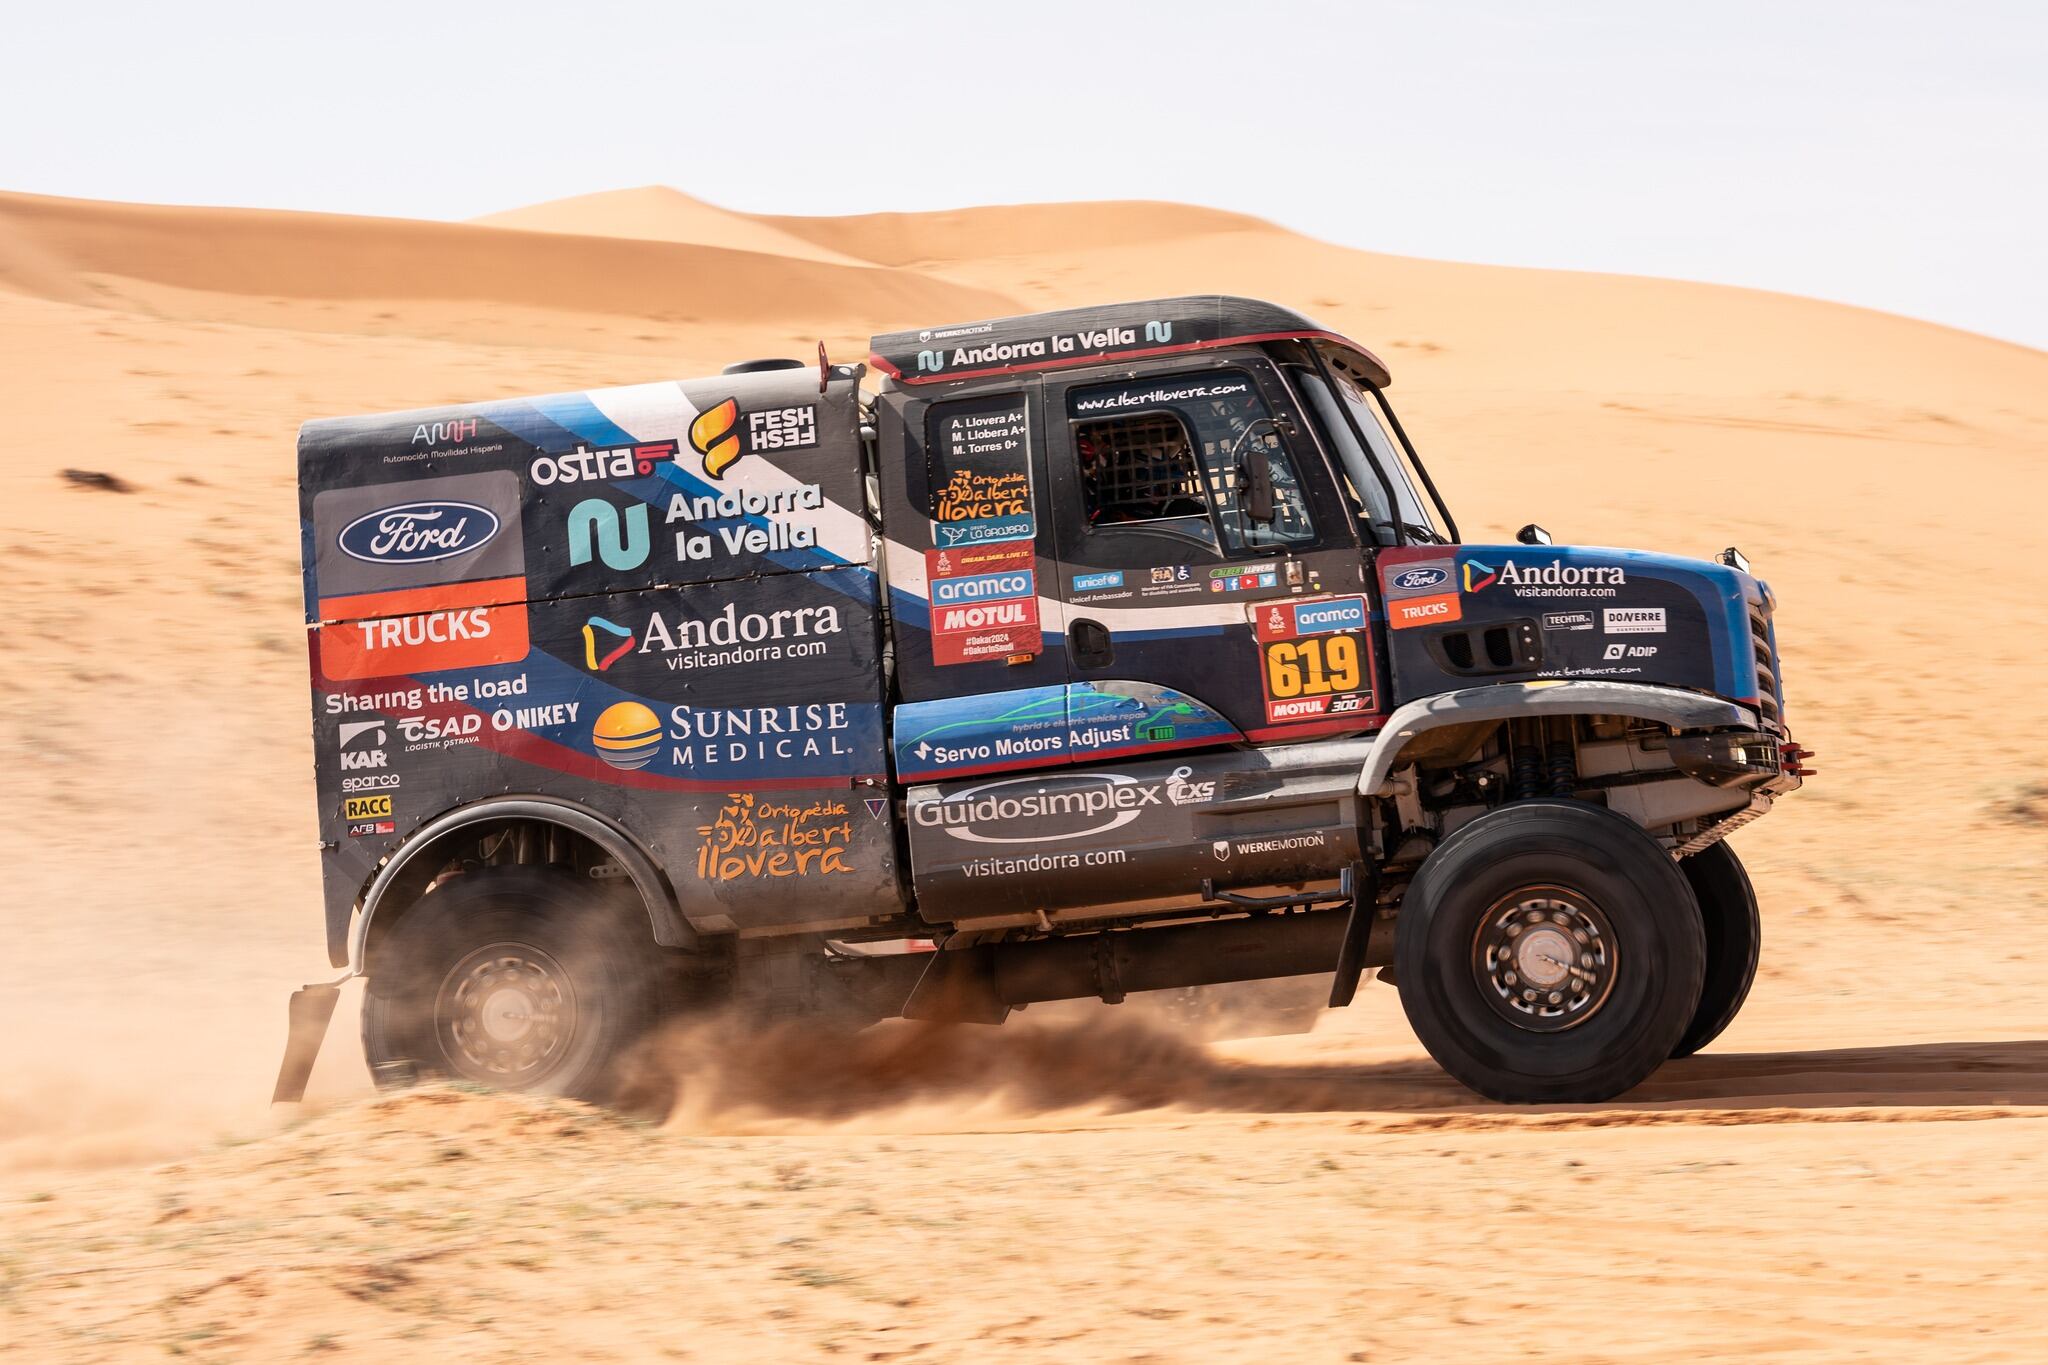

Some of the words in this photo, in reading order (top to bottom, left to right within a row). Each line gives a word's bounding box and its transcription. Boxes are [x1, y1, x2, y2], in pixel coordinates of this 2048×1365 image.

[951, 341, 1045, 366] Andorra
[1052, 334, 1073, 352] la
[1077, 327, 1135, 349] Vella
[1076, 384, 1247, 409] www.albertllovera.com
[749, 406, 814, 431] FESH
[951, 419, 963, 428] A.
[966, 414, 1005, 427] Llovera
[1007, 412, 1023, 423] A+
[951, 432, 965, 441] M.
[967, 427, 1008, 440] Llobera
[1010, 425, 1025, 435] A+
[383, 451, 428, 463] Automoción
[430, 447, 468, 458] Movilidad
[470, 443, 502, 454] Hispania
[953, 445, 965, 455] M.
[968, 441, 1002, 453] Torres
[974, 483, 1028, 500] albert
[665, 484, 822, 524] Andorra
[937, 499, 1031, 520] llovera
[369, 509, 469, 556] Ford
[675, 530, 712, 562] la
[718, 519, 816, 556] Vella
[1076, 575, 1106, 588] unicef
[1403, 571, 1437, 587] Ford
[1497, 559, 1626, 585] Andorra
[938, 576, 1026, 599] aramco
[1068, 595, 1091, 604] Unicef
[1091, 590, 1133, 602] Ambassador
[1513, 585, 1616, 597] visitandorra.com
[943, 603, 1026, 629] MOTUL
[1299, 607, 1360, 624] aramco
[1401, 602, 1448, 619] TRUCKS
[1549, 613, 1586, 624] TECHTIR
[357, 608, 492, 650] TRUCKS
[637, 602, 843, 655] Andorra
[1626, 646, 1658, 656] ADIP
[1267, 635, 1361, 698] 619
[325, 688, 422, 713] Sharing
[427, 682, 469, 702] the
[474, 672, 527, 698] load
[1273, 700, 1324, 716] MOTUL
[669, 701, 850, 741] SUNRISE
[1012, 720, 1042, 733] hybrid
[1087, 712, 1117, 723] vehicle
[1119, 710, 1148, 722] repair
[404, 740, 440, 752] LOGISTIK
[443, 735, 479, 748] OSTRAVA
[934, 744, 990, 763] Servo
[995, 734, 1061, 758] Motors
[1068, 724, 1130, 751] Adjust
[341, 773, 399, 792] sparco
[1176, 781, 1216, 799] CXS
[347, 797, 389, 816] RACC
[914, 784, 1162, 828] Guidosimplex
[759, 820, 852, 846] albert
[1236, 834, 1324, 854] WERKEMOTION
[697, 845, 856, 881] llovera
